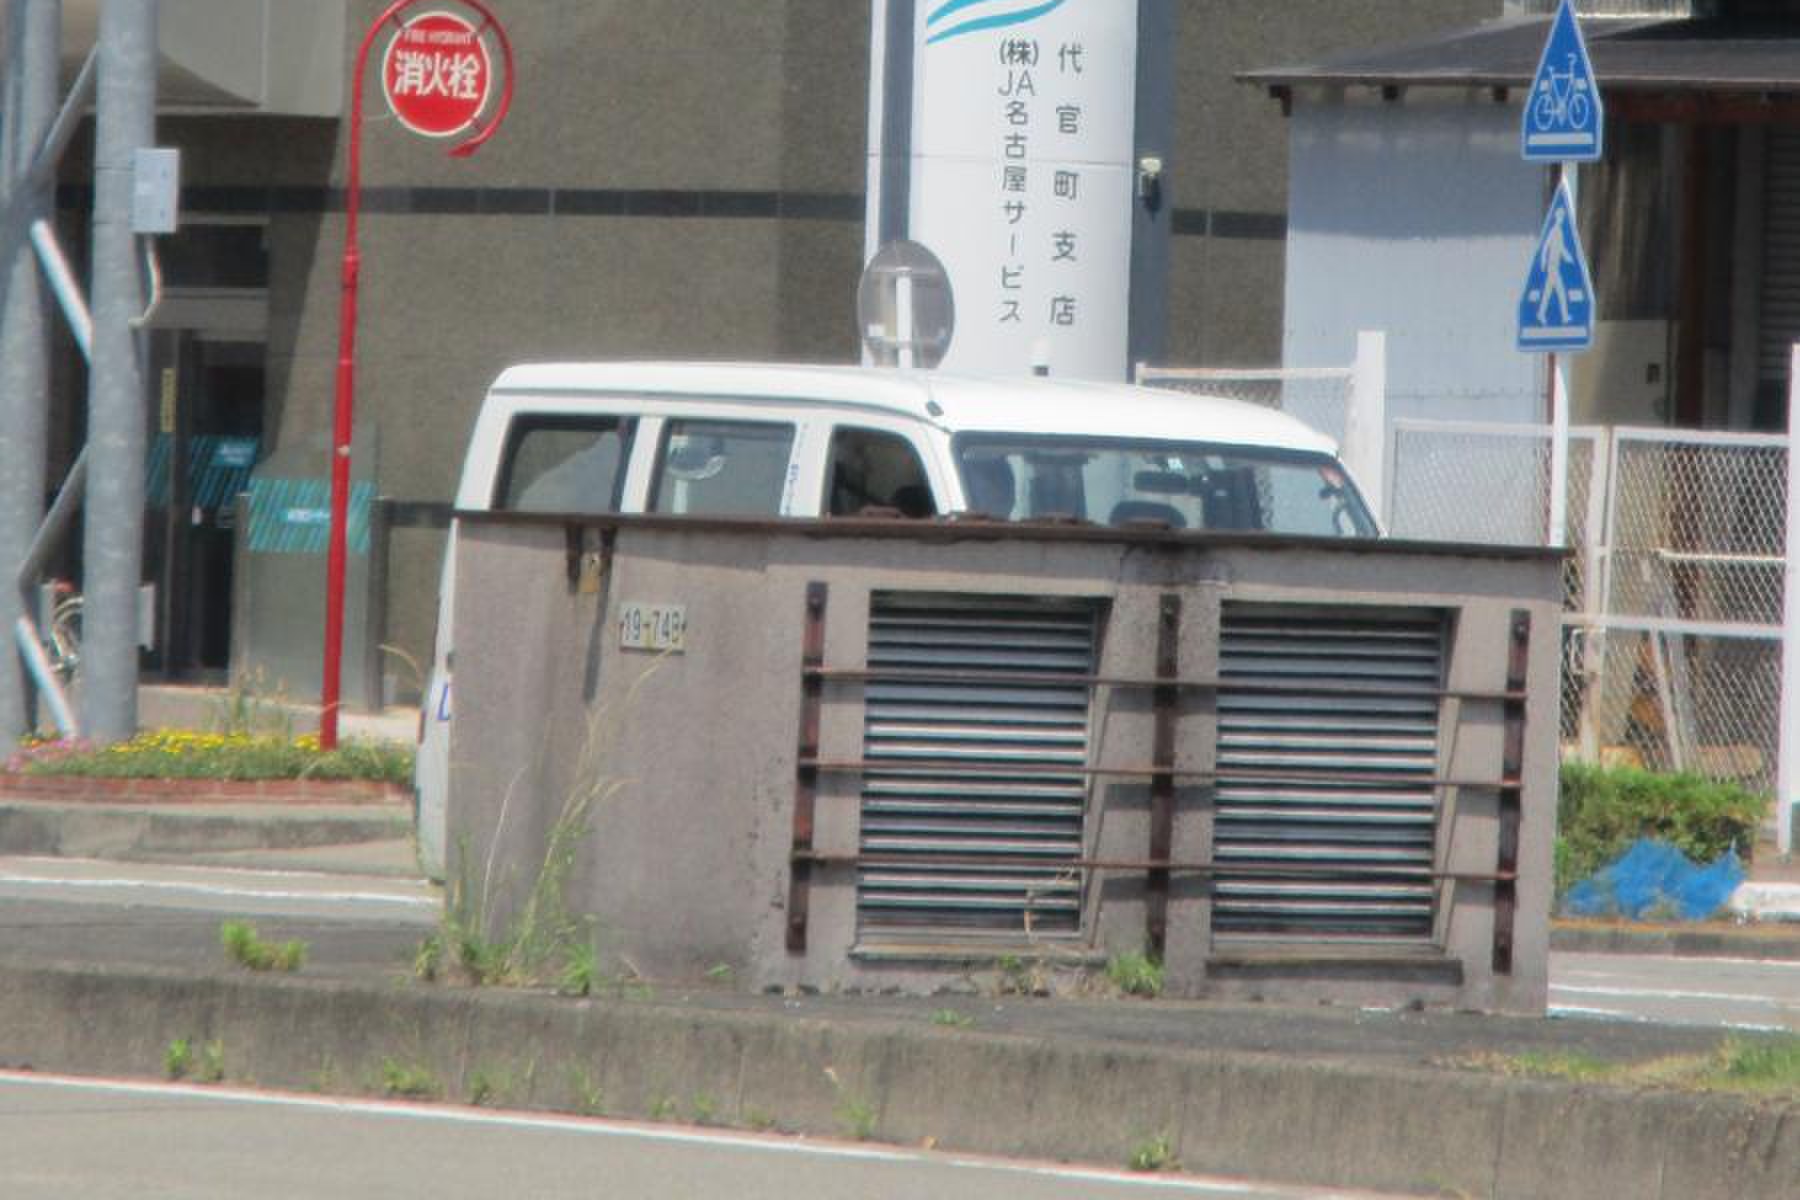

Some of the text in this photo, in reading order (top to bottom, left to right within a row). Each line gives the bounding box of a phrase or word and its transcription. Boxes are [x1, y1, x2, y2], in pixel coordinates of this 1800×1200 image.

[394, 50, 480, 99] 消火栓
[1050, 42, 1083, 326] 代官町支店
